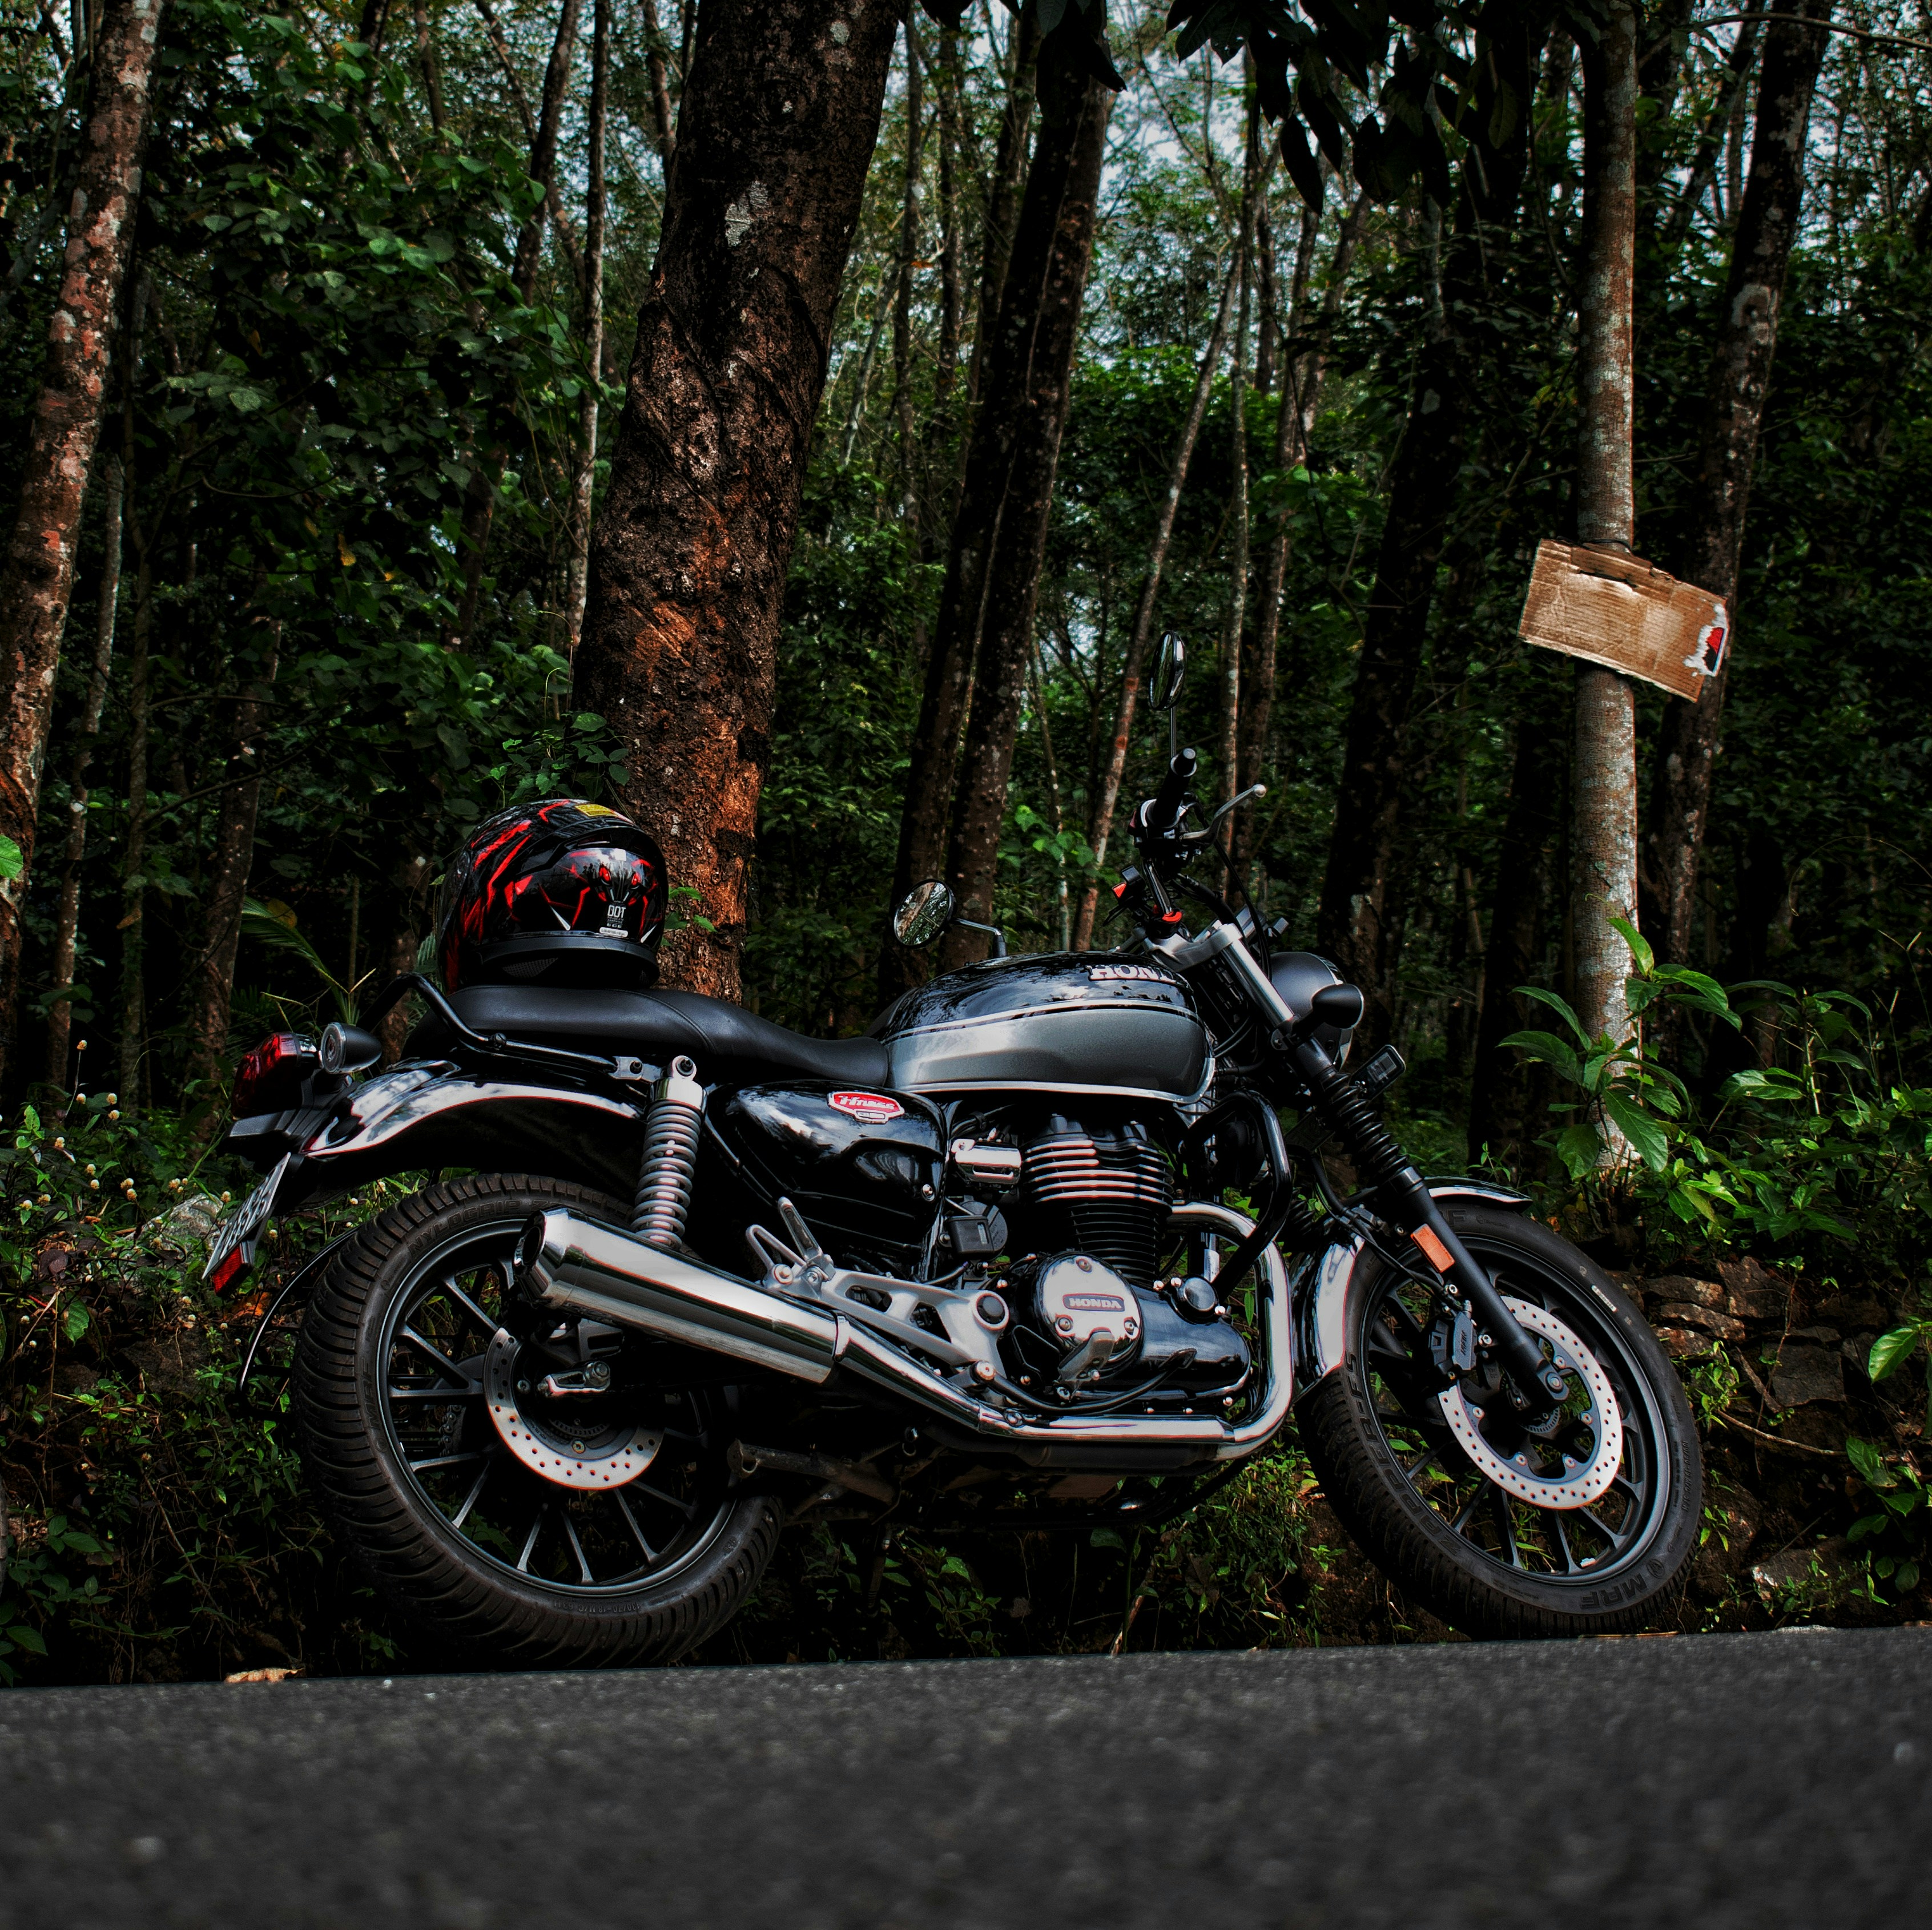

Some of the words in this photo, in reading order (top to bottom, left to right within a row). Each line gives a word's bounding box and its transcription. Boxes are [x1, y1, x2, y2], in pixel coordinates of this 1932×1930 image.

[607, 905, 626, 918] DOT
[1086, 964, 1184, 985] HOND
[1069, 1298, 1122, 1308] HONDA
[1580, 1573, 1648, 1610] MRF
